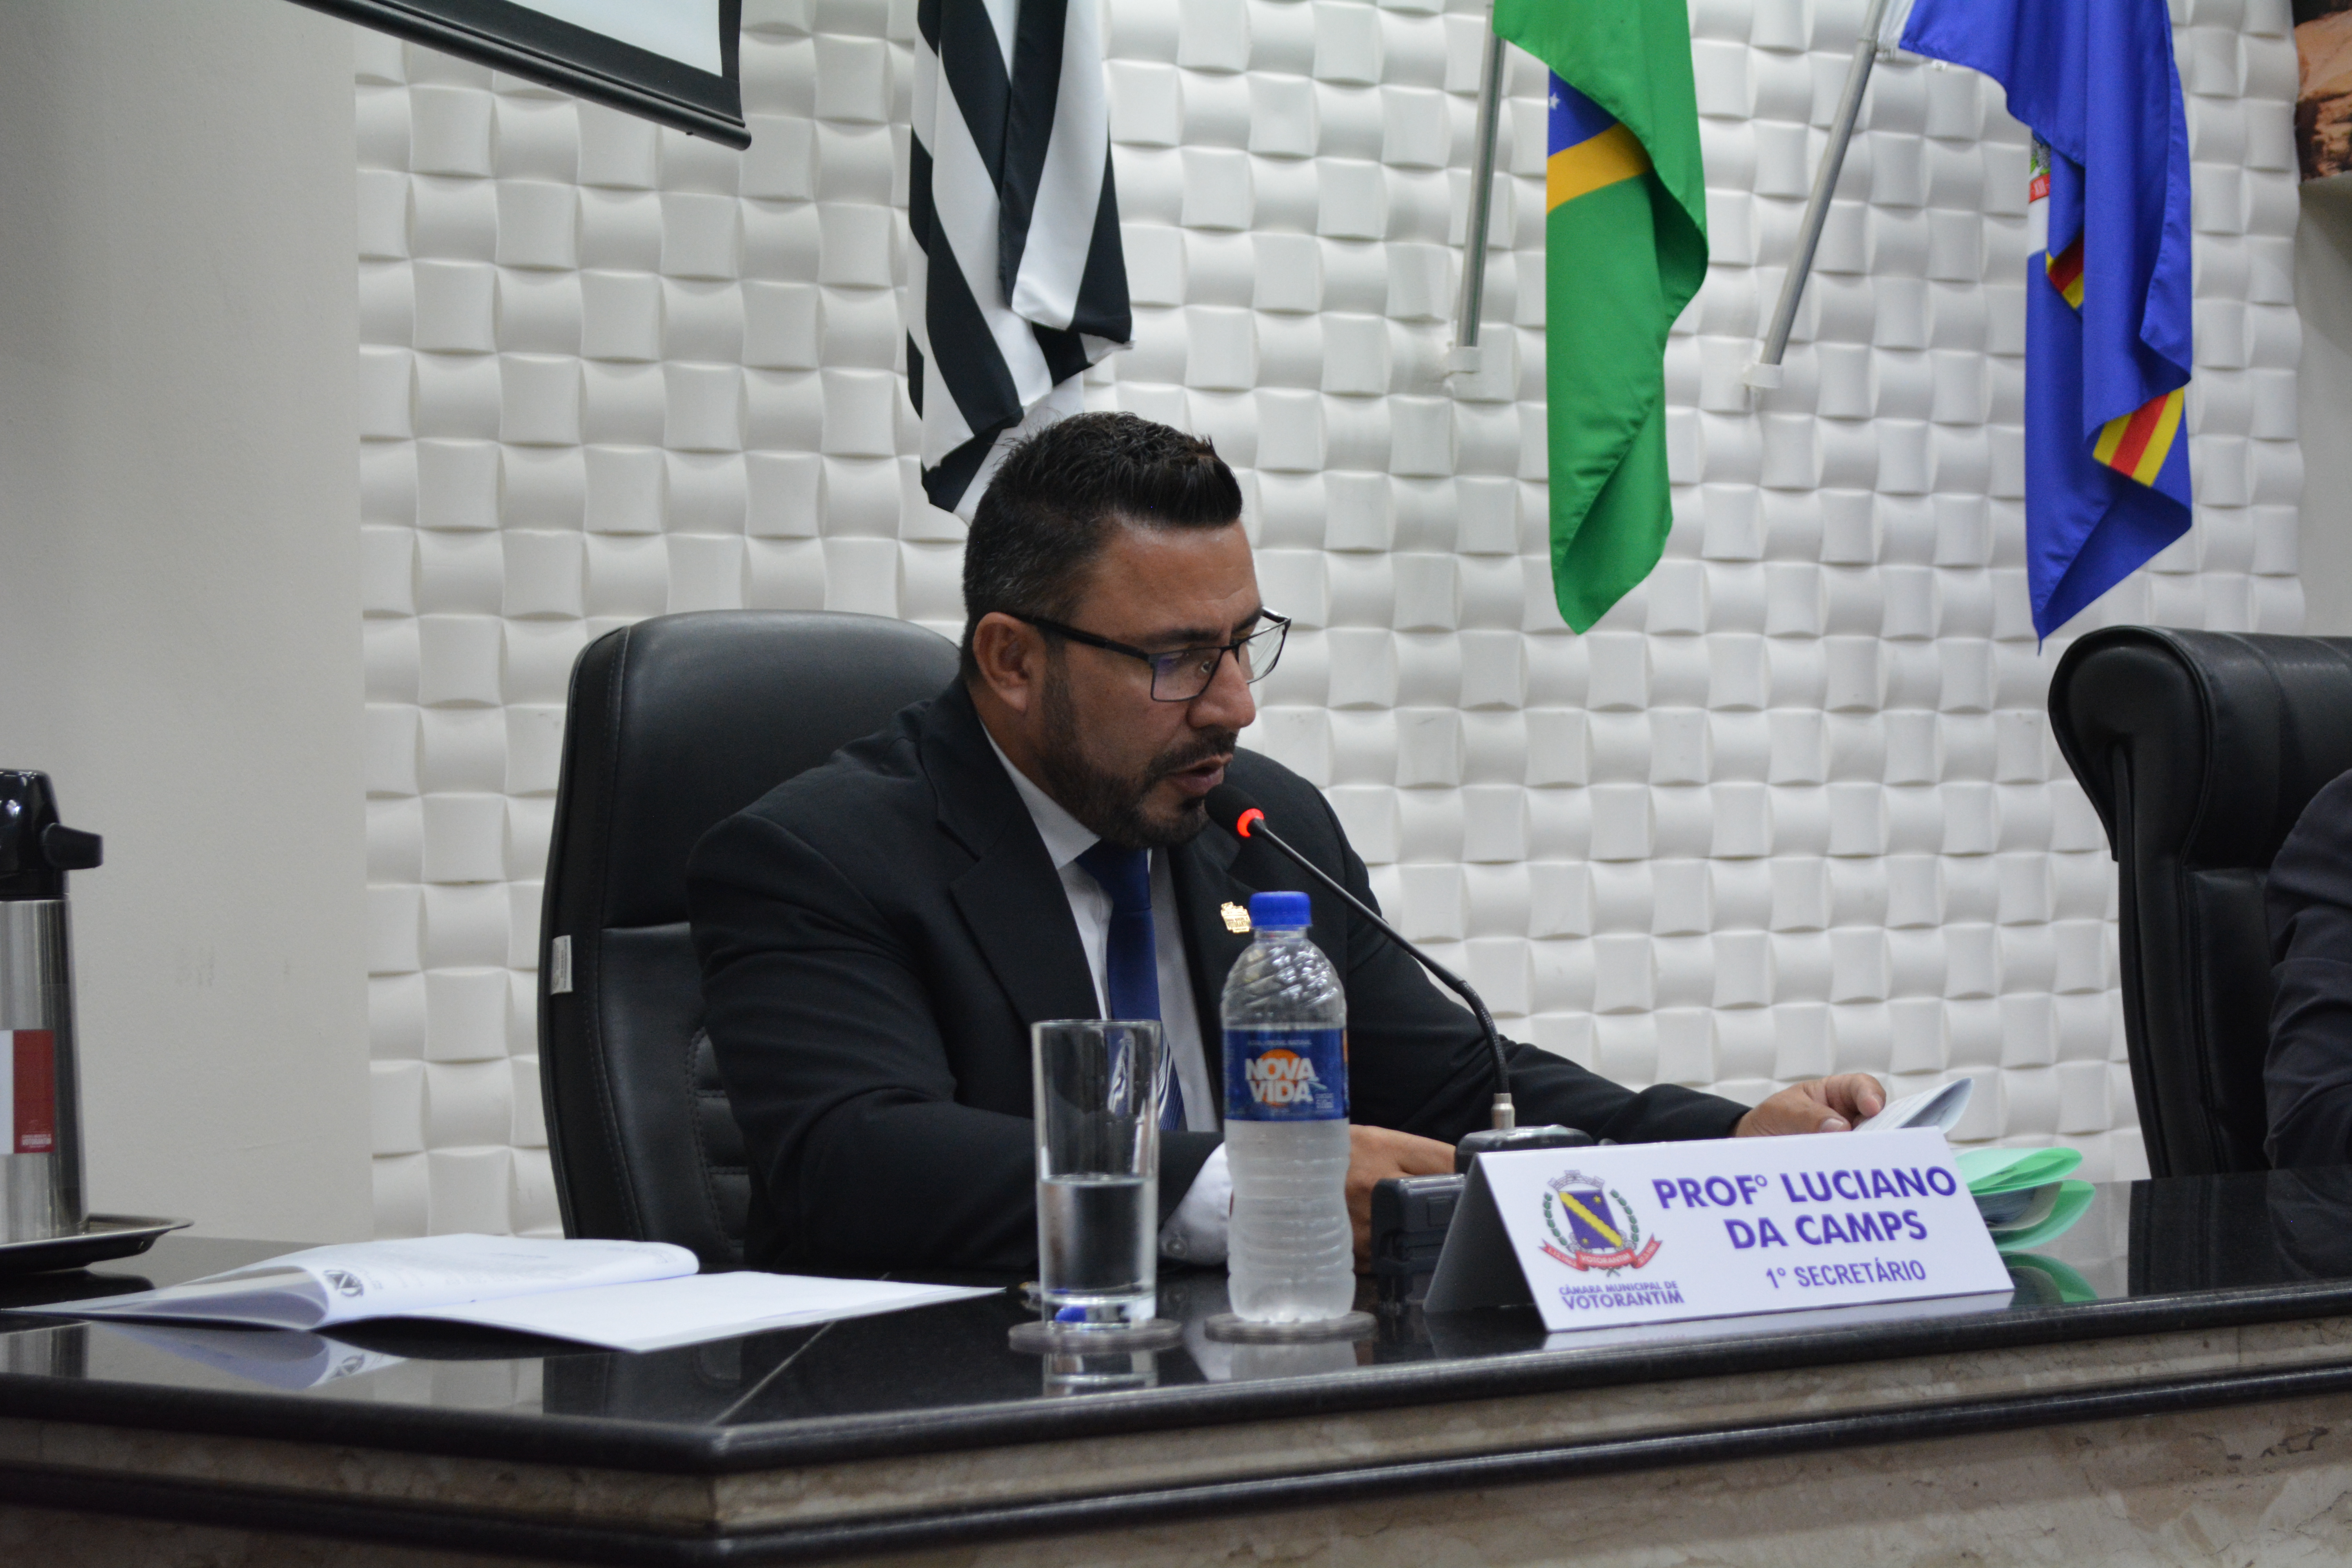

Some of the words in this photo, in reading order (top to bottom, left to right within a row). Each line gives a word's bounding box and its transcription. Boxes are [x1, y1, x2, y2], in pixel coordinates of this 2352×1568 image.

[1245, 1058, 1316, 1080] NOVA
[1249, 1080, 1313, 1102] VIDA
[1779, 1166, 1957, 1203] LUCIANO
[1723, 1216, 1789, 1249] DA
[1795, 1209, 1928, 1245] CAMPS
[1579, 1252, 1632, 1264] VOTORANTIM
[1793, 1257, 1926, 1287] SECRETÁRIO
[1559, 1284, 1603, 1295] CÂMARA
[1605, 1281, 1663, 1293] MUNICIPAL
[1664, 1280, 1678, 1289] DE
[1561, 1289, 1685, 1310] VOTORANTIM
